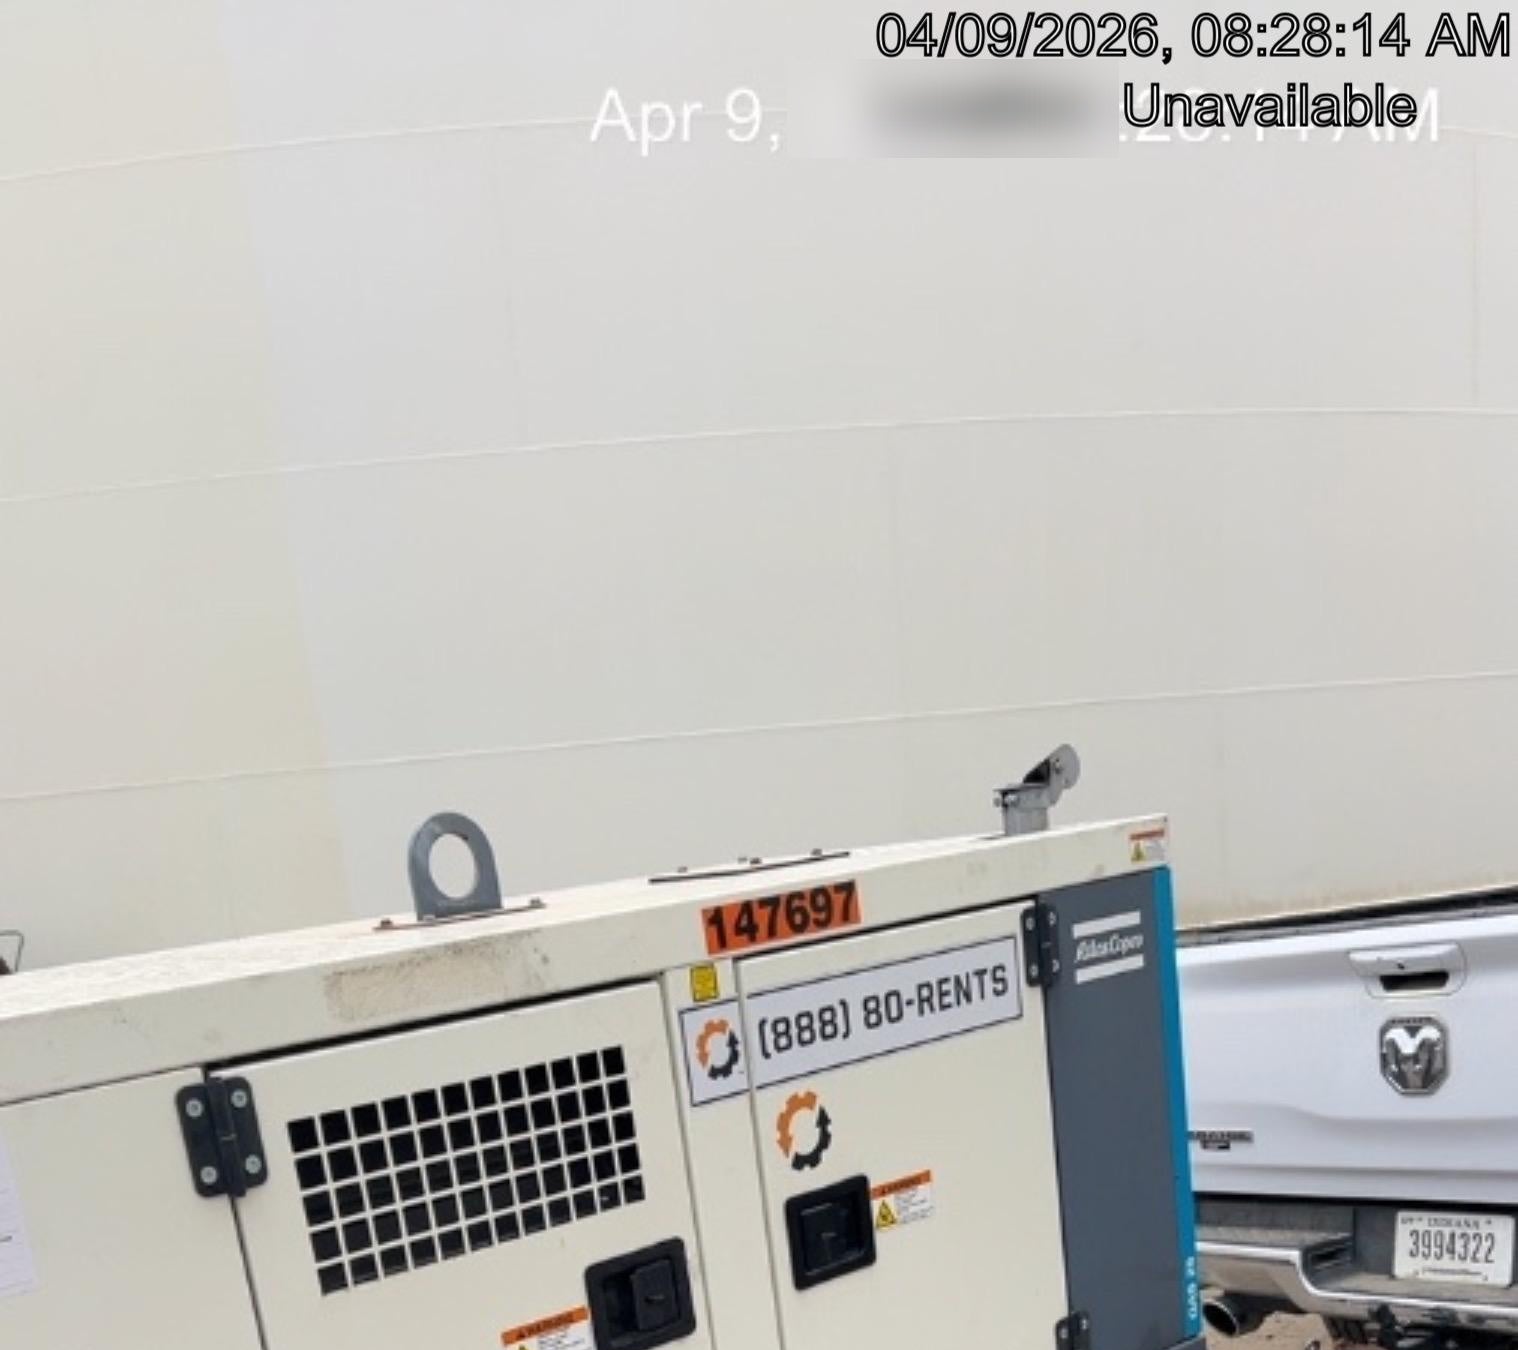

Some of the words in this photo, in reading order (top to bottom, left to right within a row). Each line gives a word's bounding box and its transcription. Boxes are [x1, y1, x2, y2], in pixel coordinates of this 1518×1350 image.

[706, 880, 859, 949] 147697
[757, 998, 852, 1060] (888)
[862, 963, 1010, 1030] 80-RENTS
[1408, 1228, 1496, 1264] 3994322
